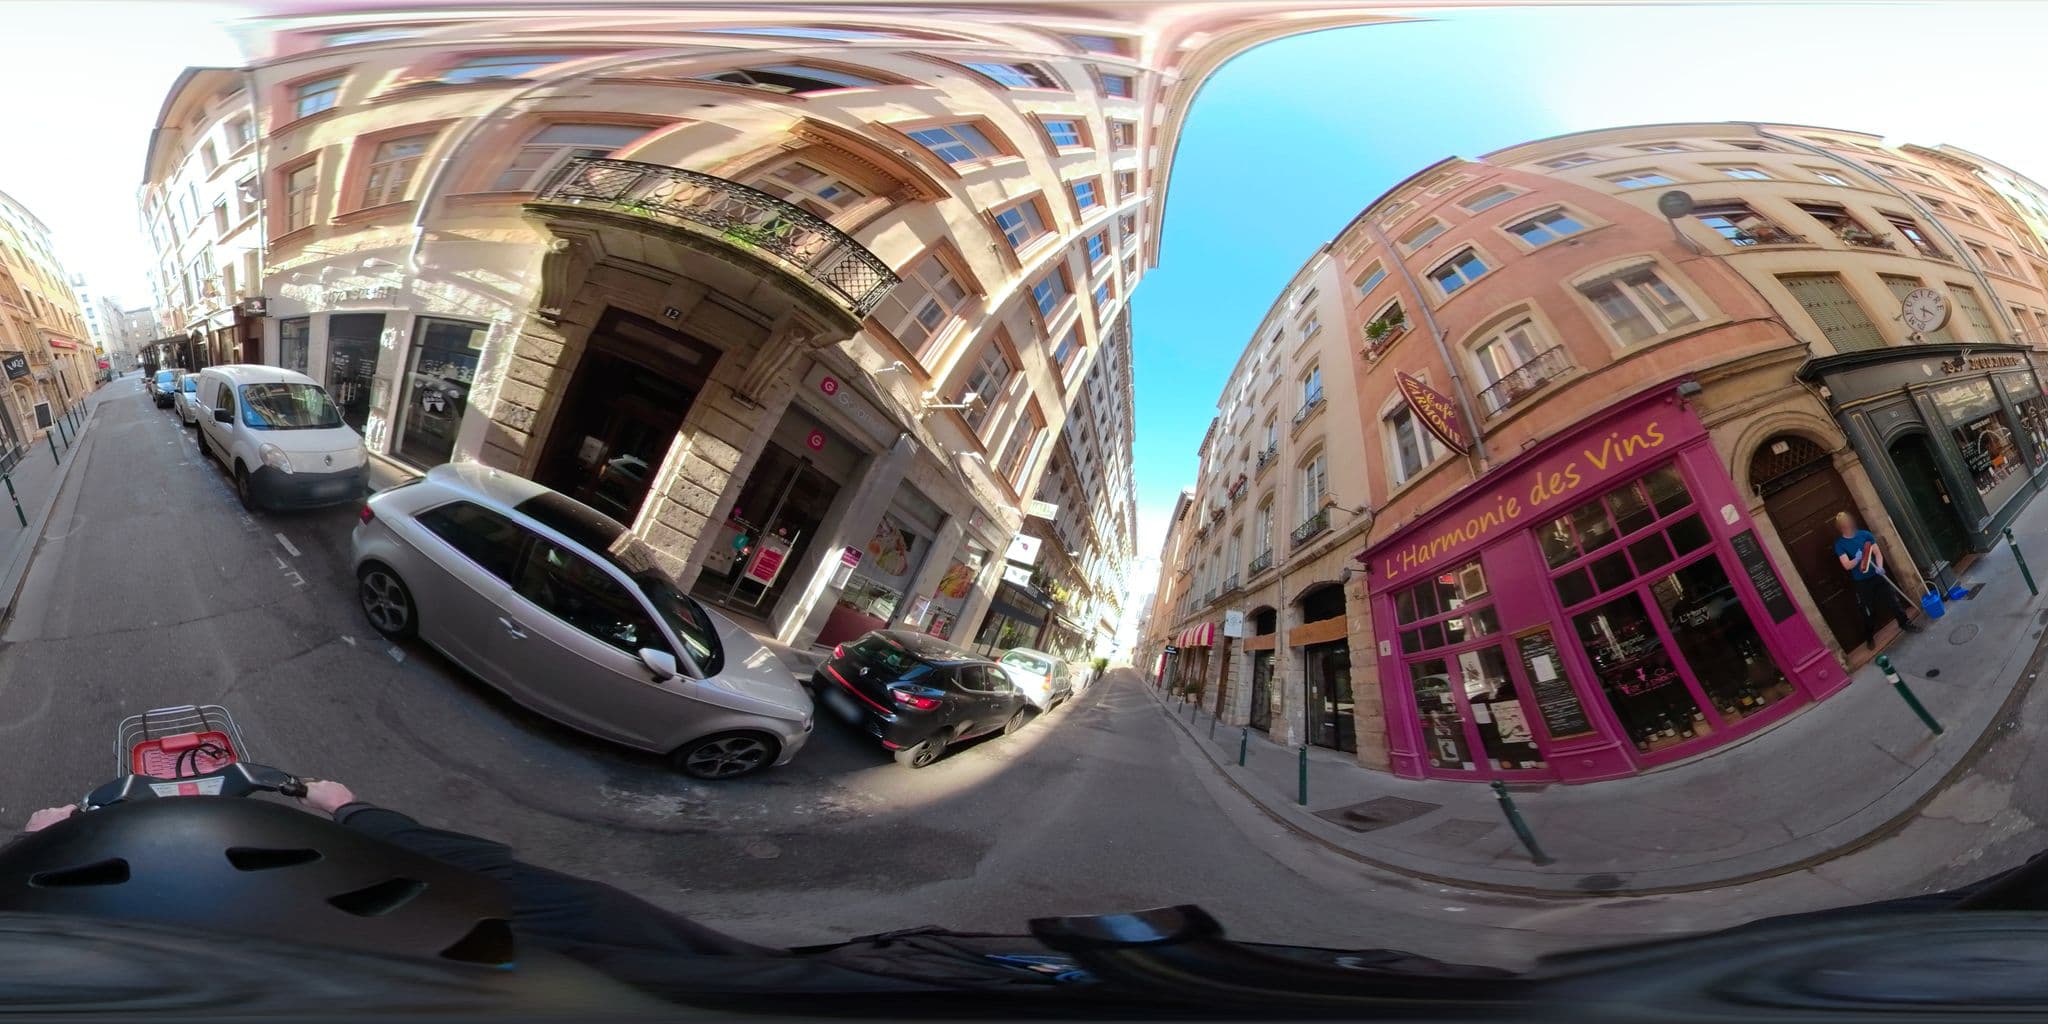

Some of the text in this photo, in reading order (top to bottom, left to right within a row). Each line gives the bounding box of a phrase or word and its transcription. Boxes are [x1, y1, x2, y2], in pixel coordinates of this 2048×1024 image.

[665, 308, 680, 320] 12
[1385, 422, 1665, 580] L'Harmonie des Vins
